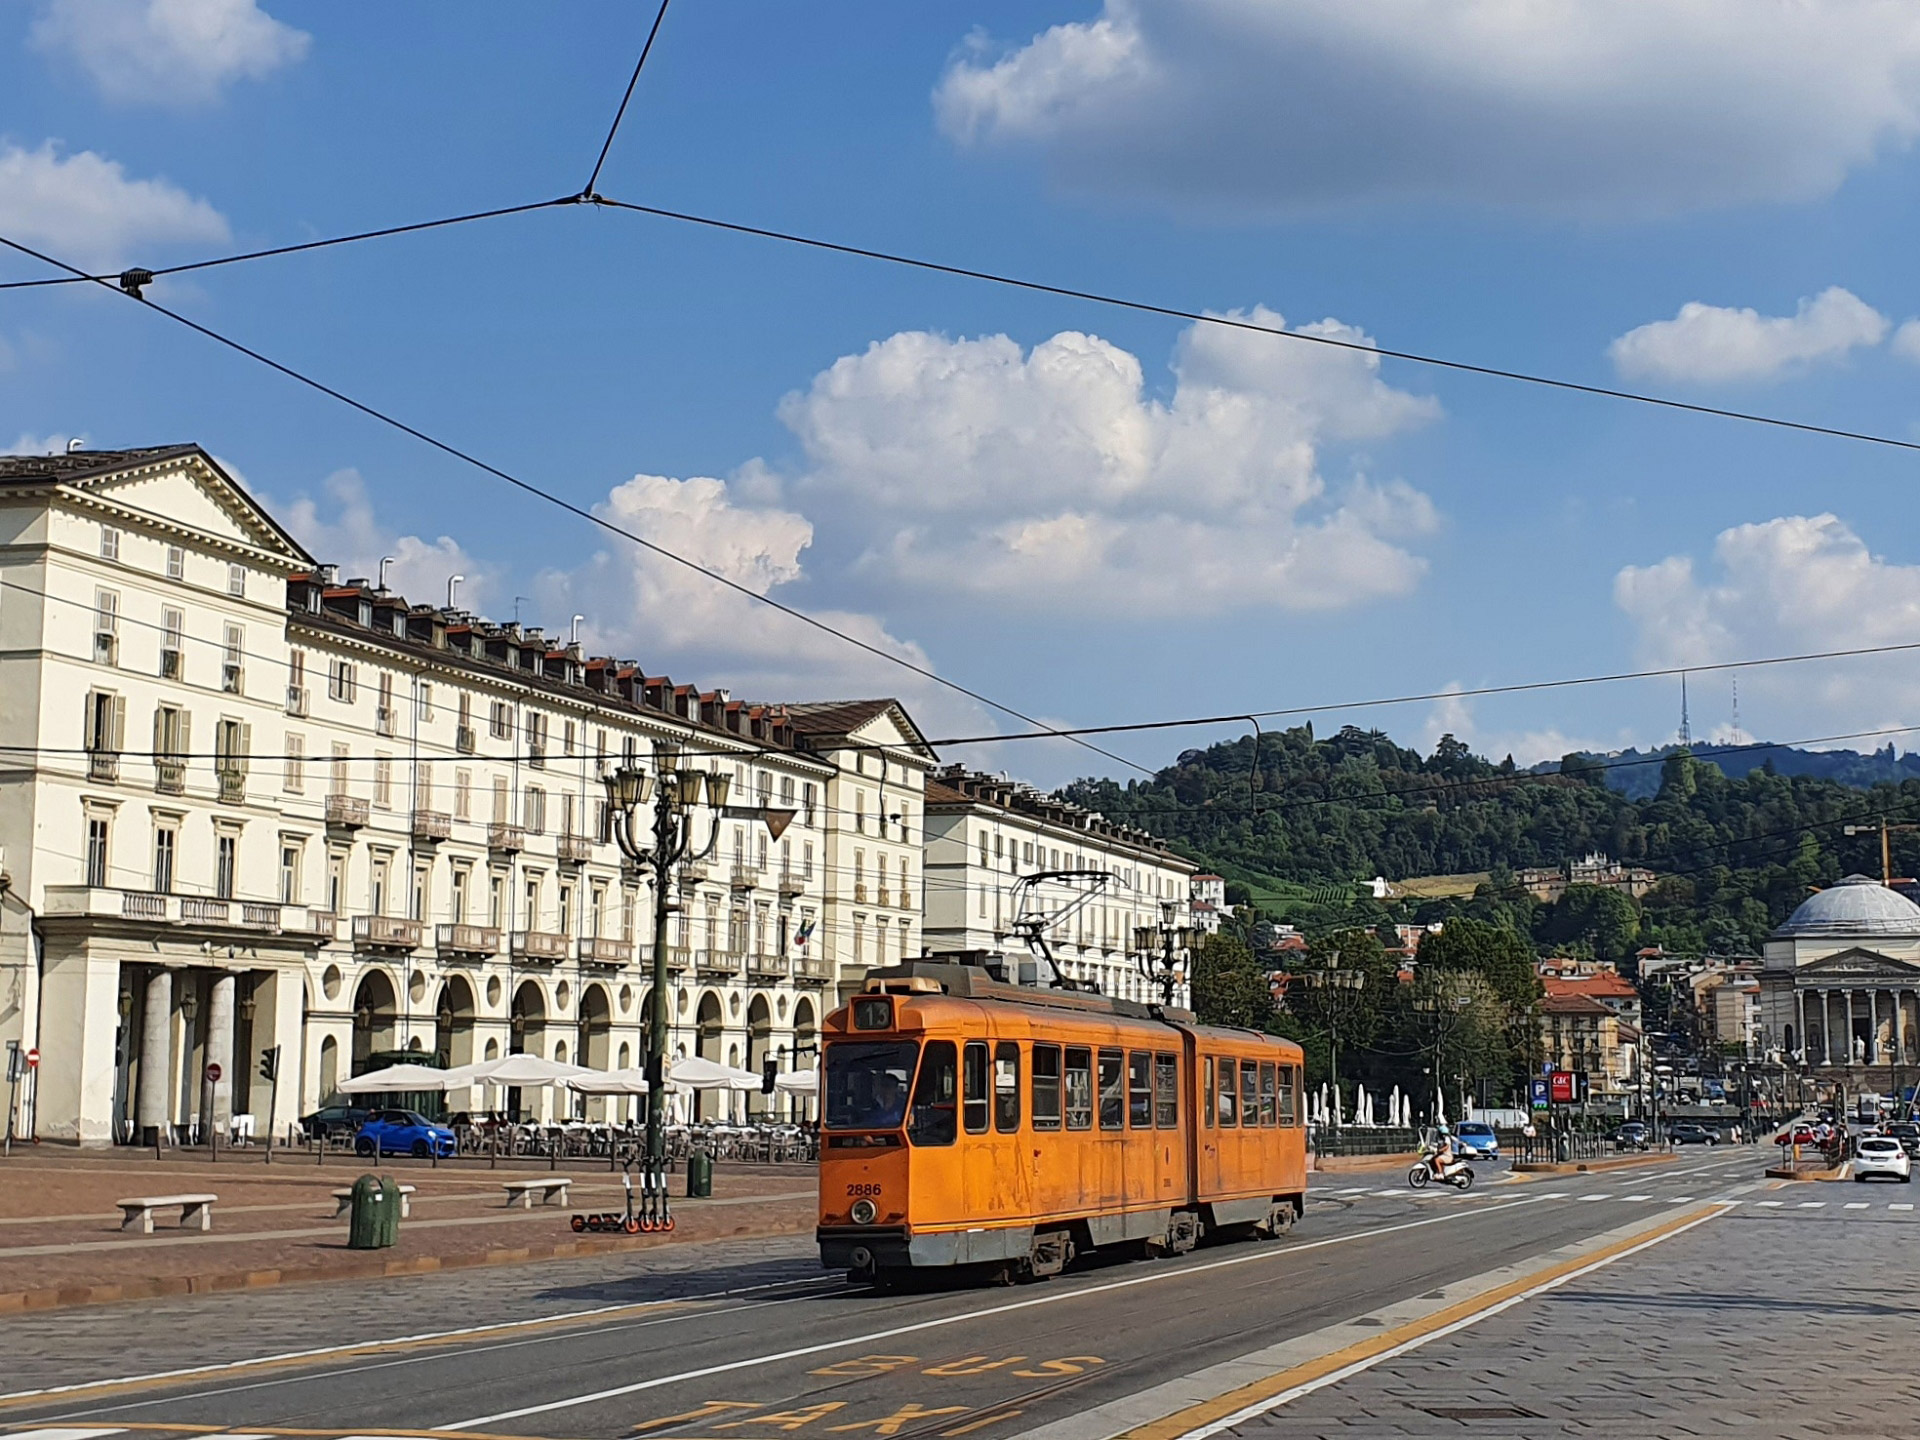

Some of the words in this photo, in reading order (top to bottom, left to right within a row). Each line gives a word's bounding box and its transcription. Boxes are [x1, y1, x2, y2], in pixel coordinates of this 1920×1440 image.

[865, 1003, 889, 1026] 13
[1535, 1084, 1546, 1096] P
[846, 1183, 882, 1196] 2886
[806, 1355, 1106, 1378] BUS
[632, 1401, 1023, 1437] TAXI
